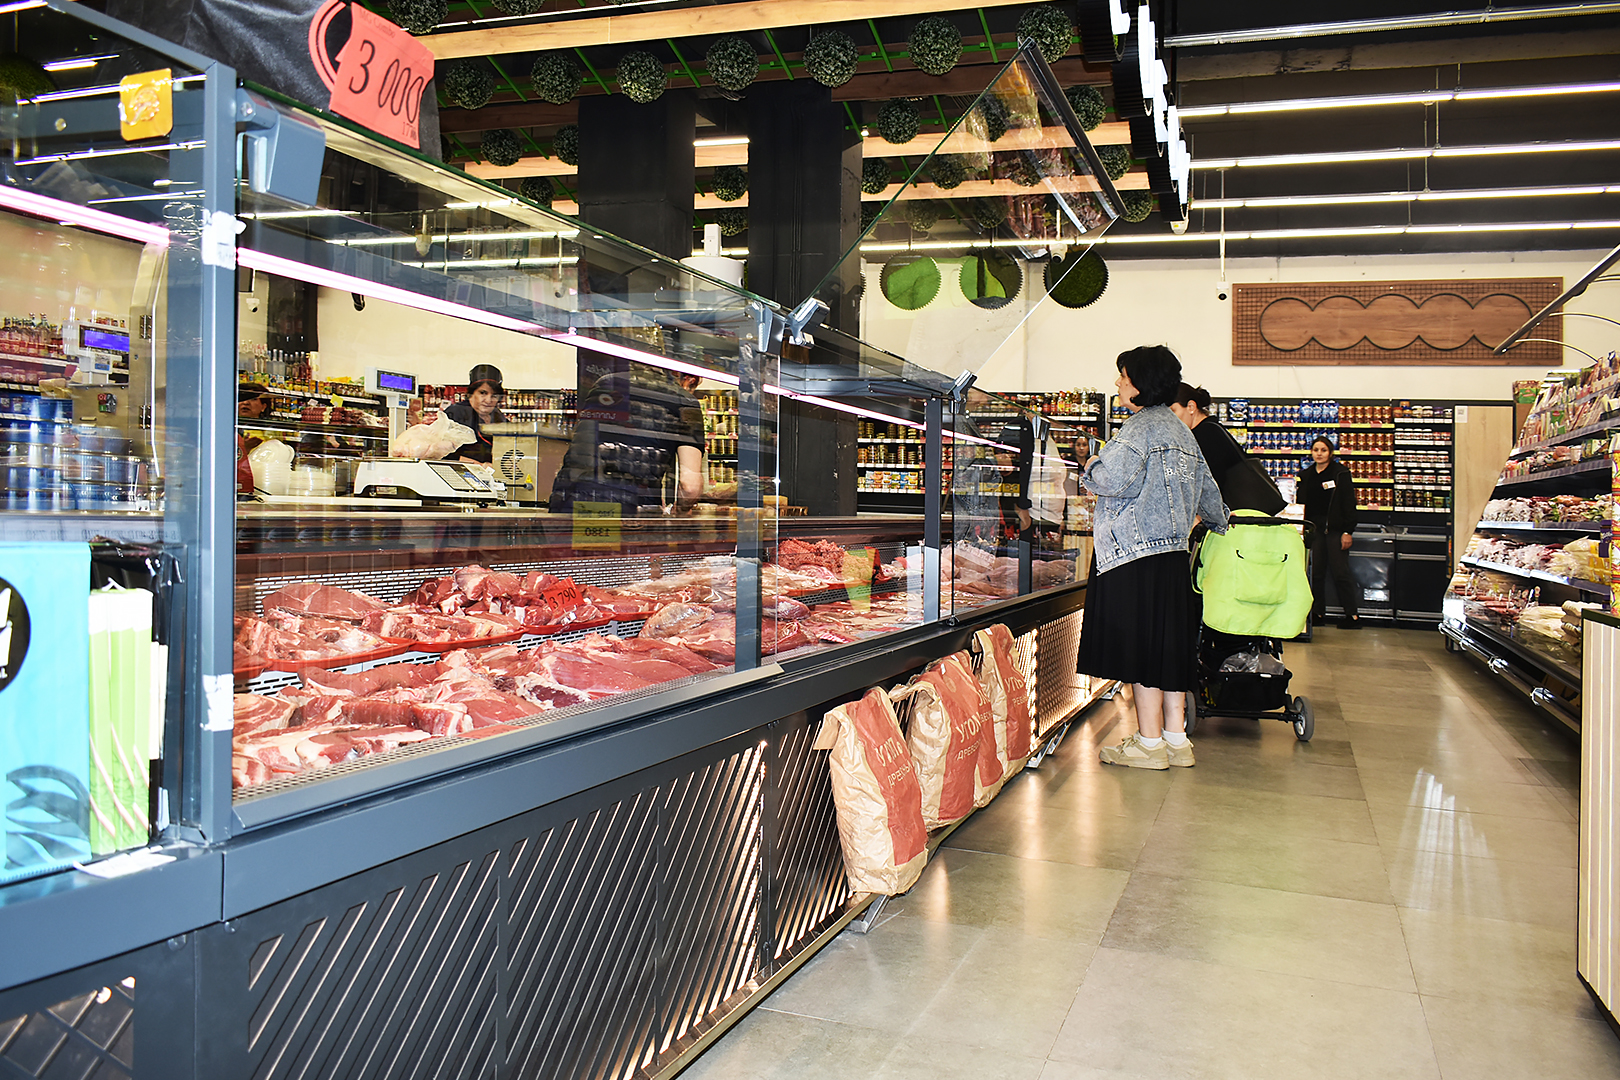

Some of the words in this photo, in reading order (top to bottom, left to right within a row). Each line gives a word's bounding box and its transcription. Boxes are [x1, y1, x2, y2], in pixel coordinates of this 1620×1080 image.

[348, 39, 376, 95] 3
[378, 58, 425, 124] 000
[557, 586, 577, 605] 790
